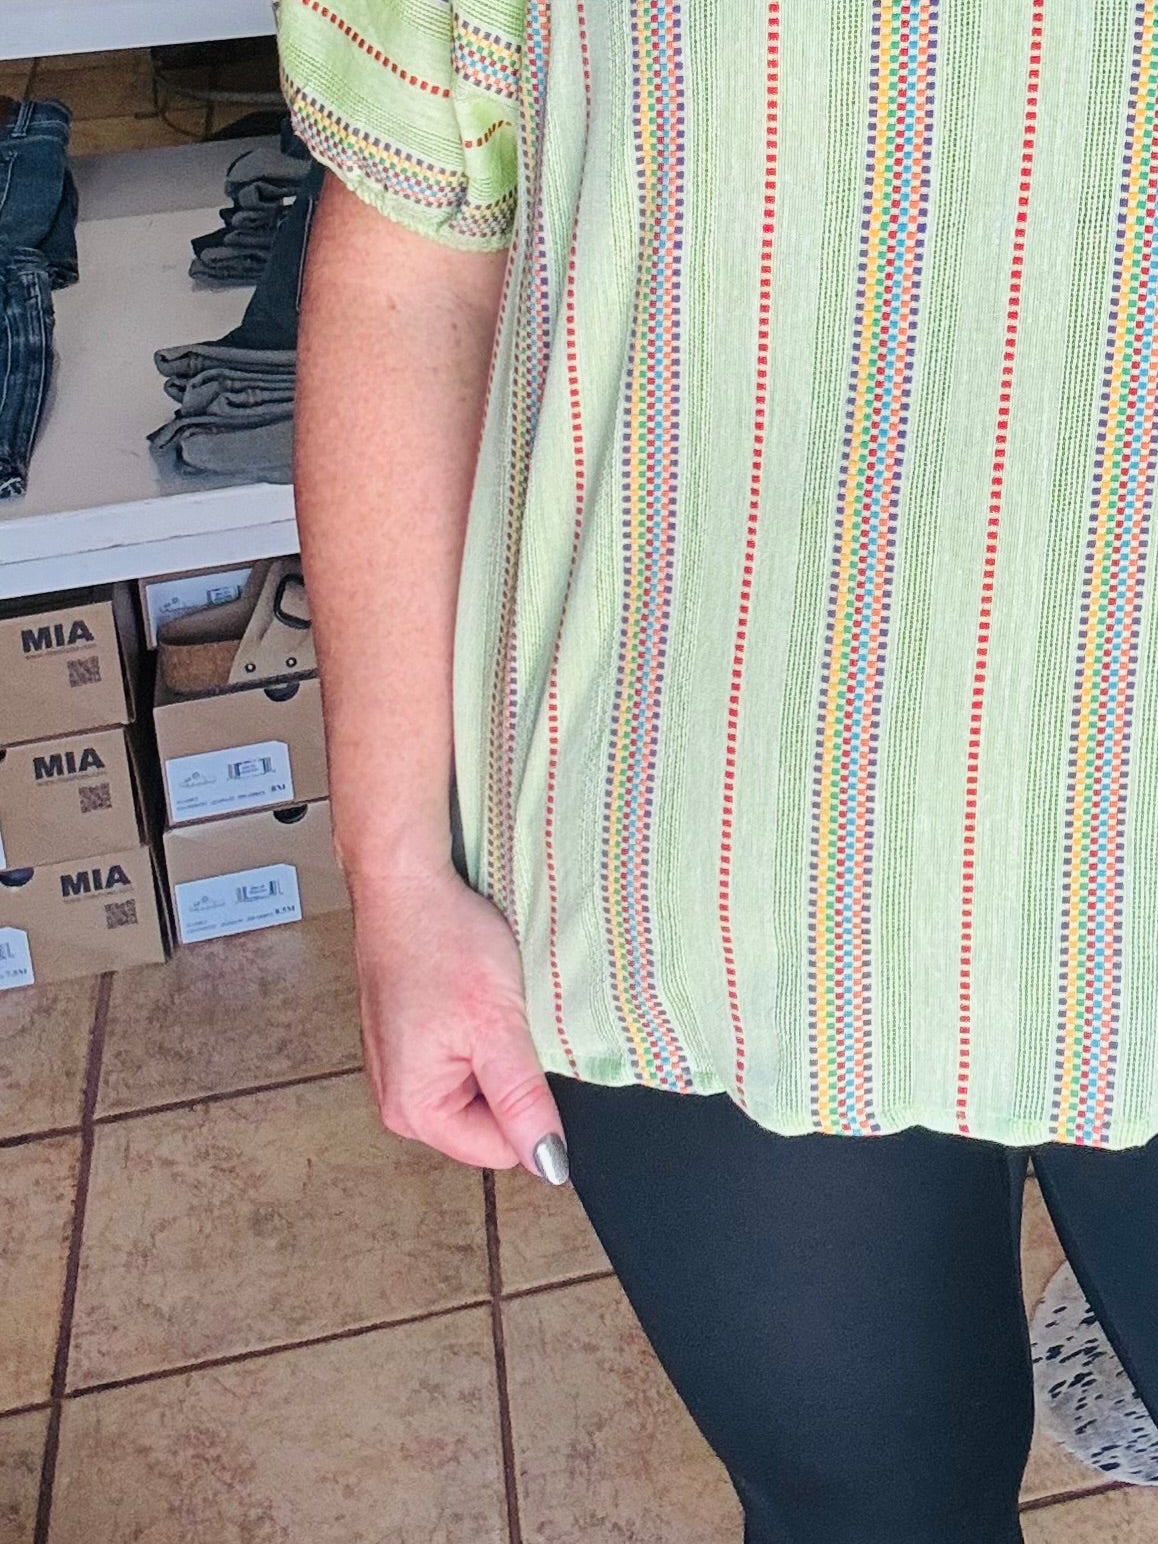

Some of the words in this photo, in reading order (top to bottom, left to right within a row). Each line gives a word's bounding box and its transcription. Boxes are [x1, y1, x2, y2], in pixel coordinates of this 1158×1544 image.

[21, 620, 94, 653] MIA
[33, 747, 105, 780] MIA
[60, 865, 131, 897] MIA
